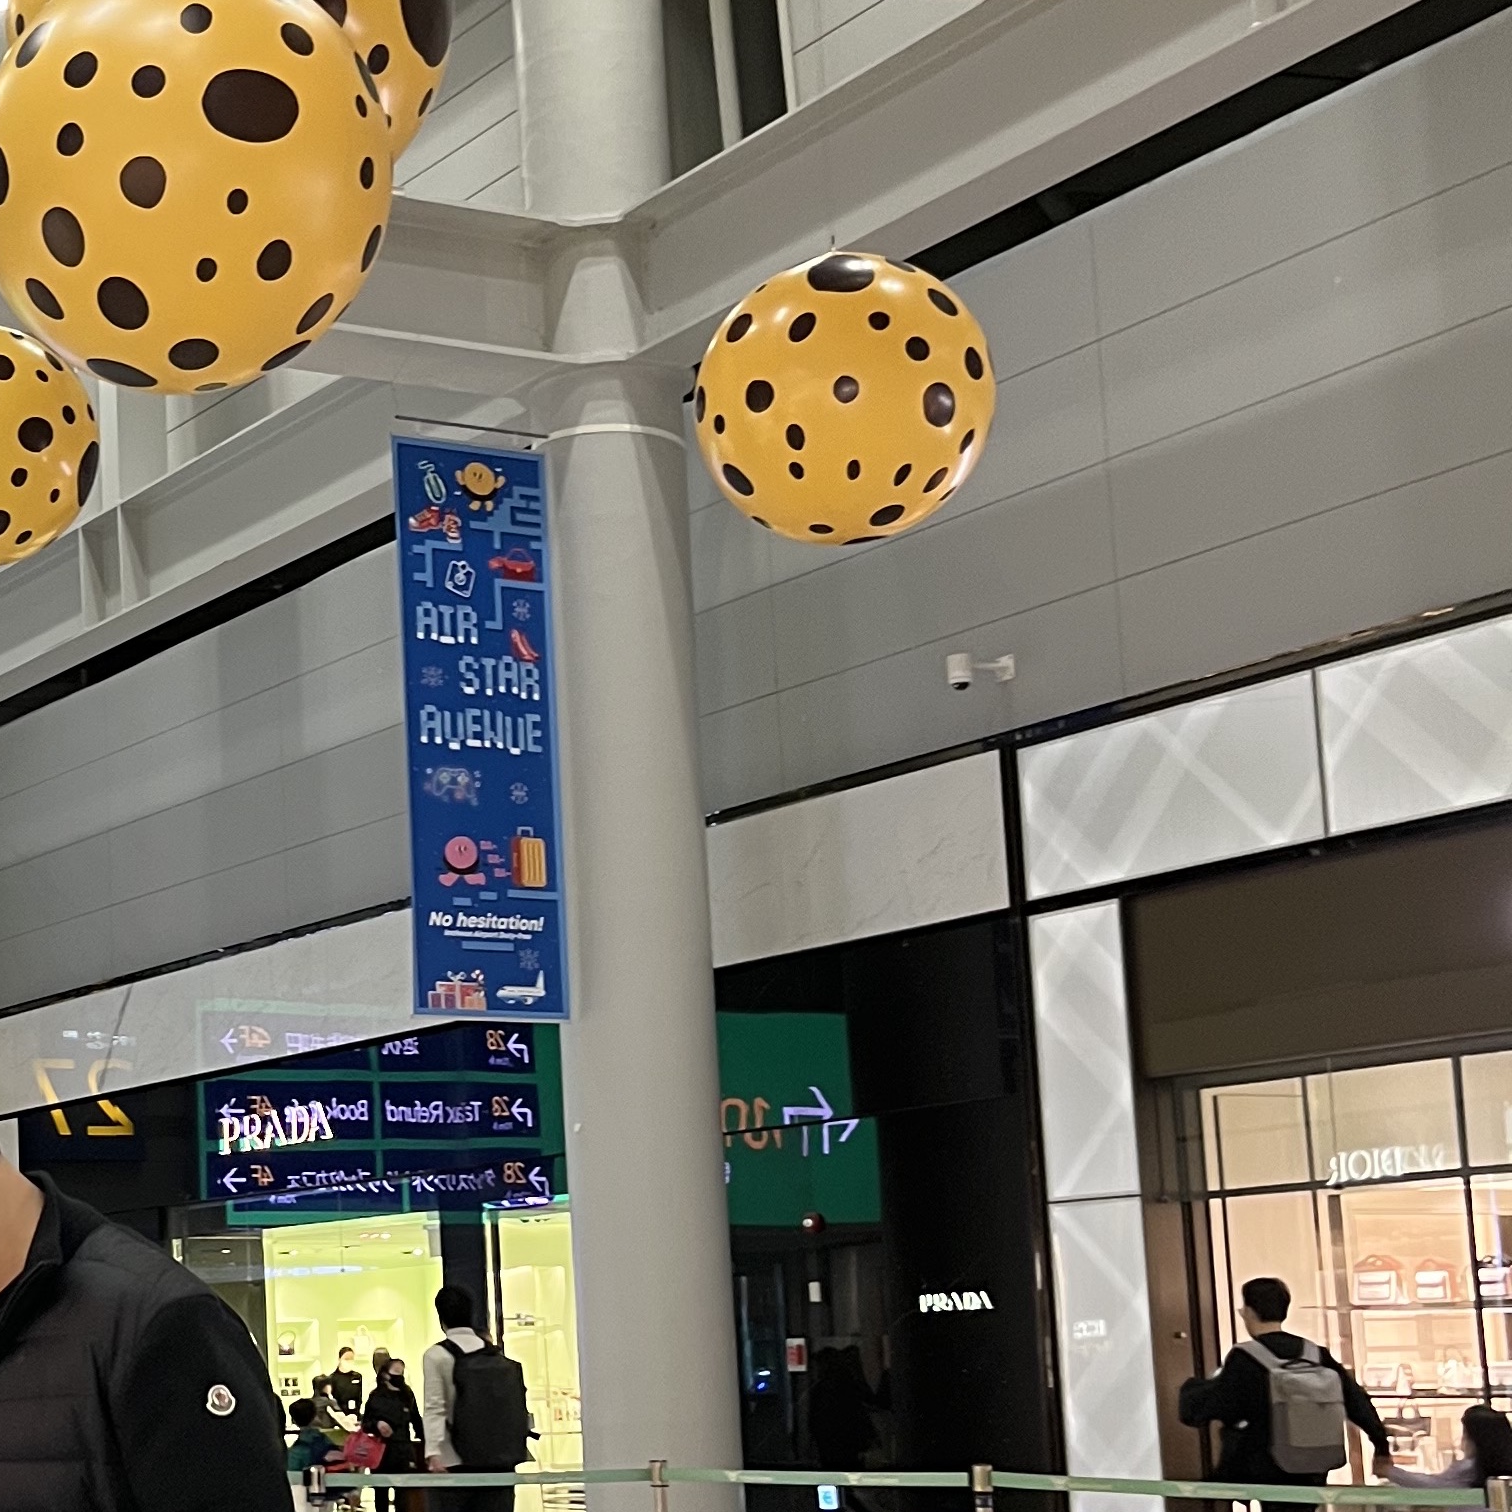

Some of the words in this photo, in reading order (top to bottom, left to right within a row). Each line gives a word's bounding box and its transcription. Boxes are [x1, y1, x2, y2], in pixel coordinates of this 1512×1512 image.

[416, 601, 478, 645] AIR
[458, 655, 540, 700] STAR
[419, 704, 543, 755] AVENUE
[429, 911, 453, 926] No
[456, 912, 544, 931] hesitation!
[218, 1100, 334, 1155] PRADA
[919, 1291, 994, 1312] PRADA
